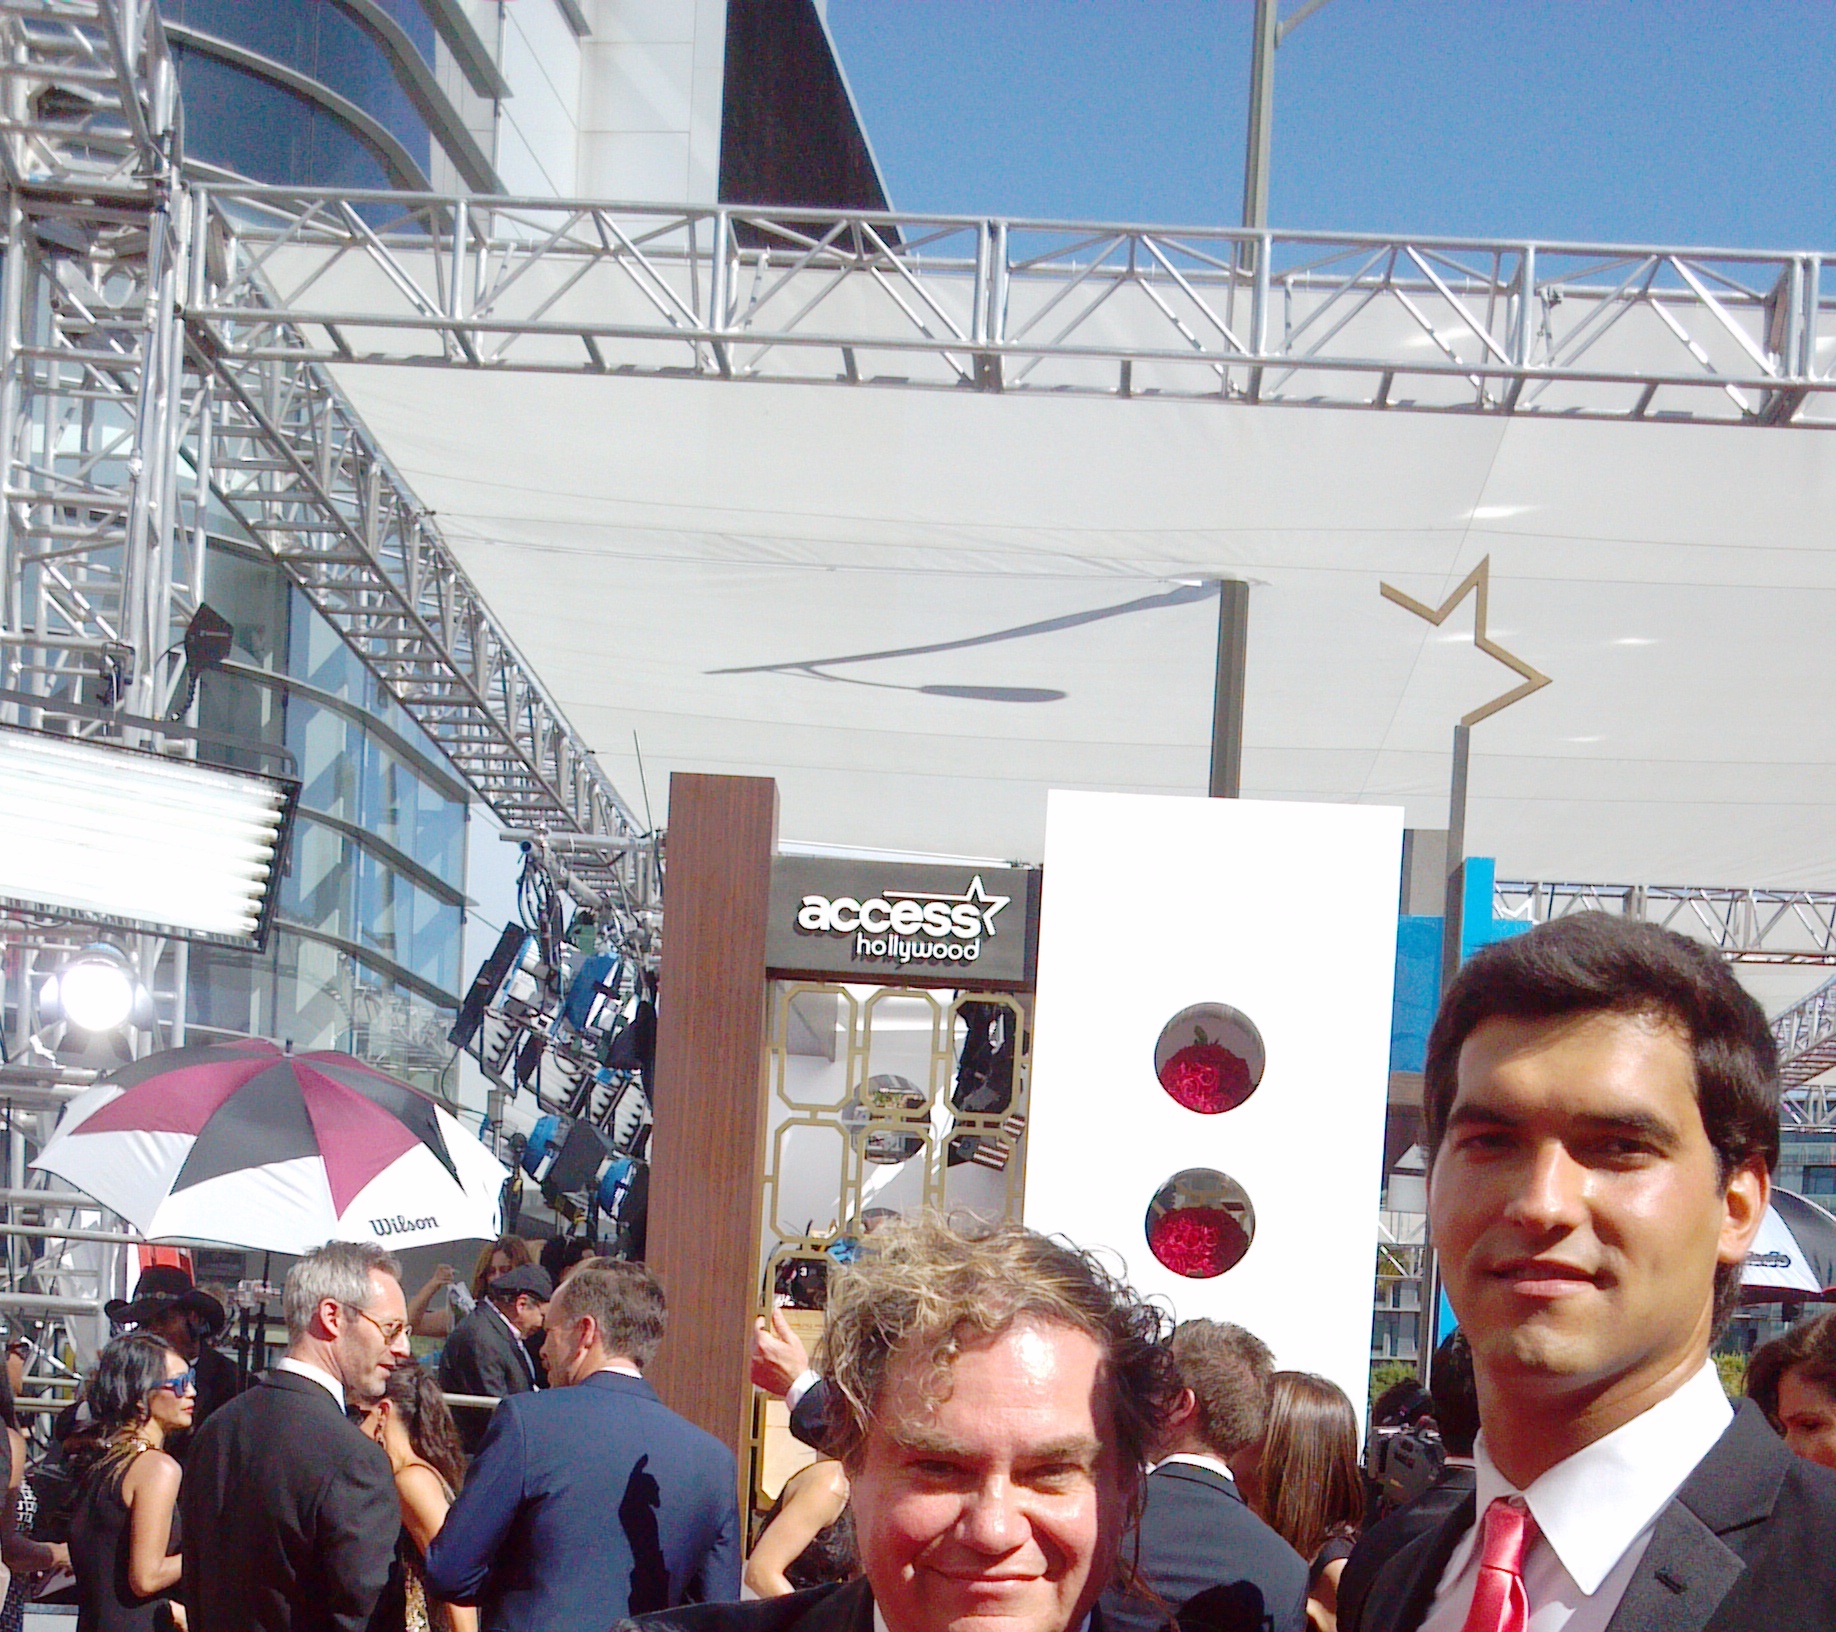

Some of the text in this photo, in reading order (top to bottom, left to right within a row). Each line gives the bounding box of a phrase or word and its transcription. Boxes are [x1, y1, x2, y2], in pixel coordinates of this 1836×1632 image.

[797, 895, 982, 939] access
[856, 931, 981, 963] hollywood
[368, 1214, 440, 1236] Wilson
